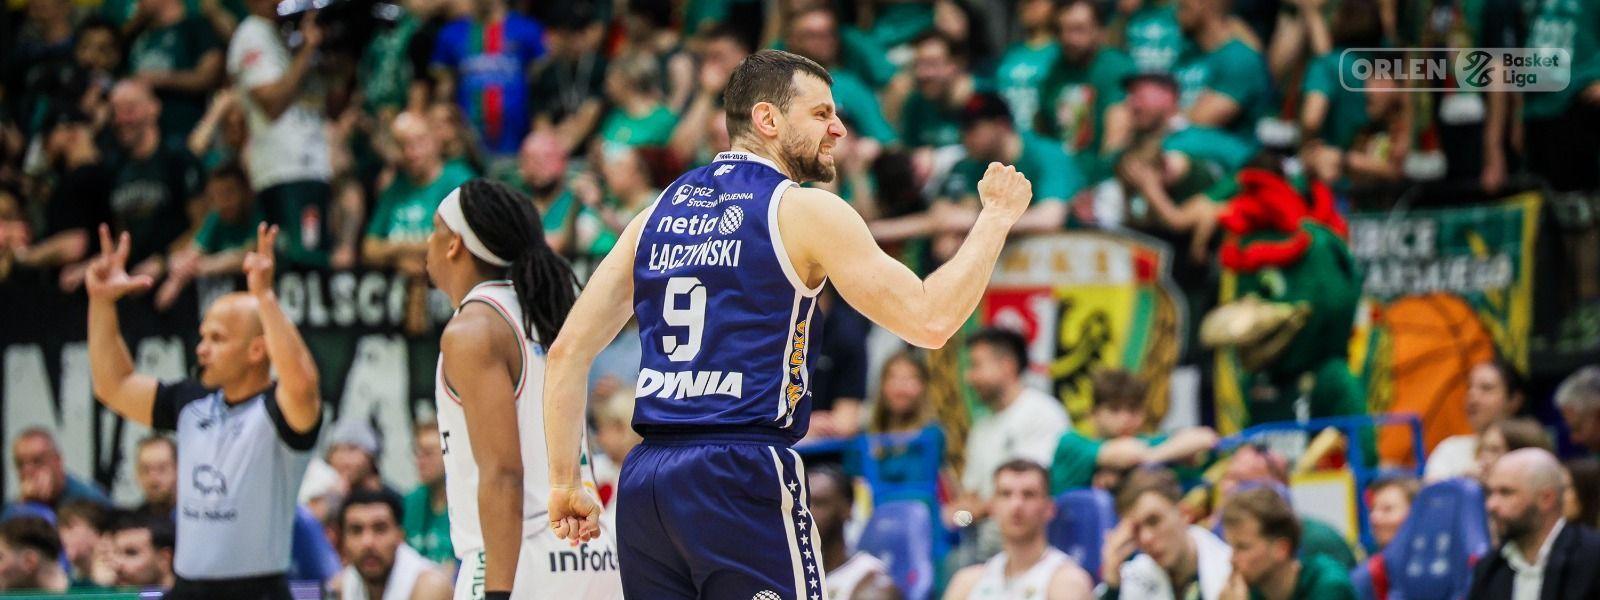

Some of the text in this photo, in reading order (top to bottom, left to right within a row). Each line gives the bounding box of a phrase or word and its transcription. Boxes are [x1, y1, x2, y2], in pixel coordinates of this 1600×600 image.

[692, 187, 714, 197] PGZ
[656, 213, 719, 236] netia
[648, 236, 742, 274] ŁĄCZYŃSKI
[662, 276, 707, 362] 9
[634, 367, 743, 400] DYNIA
[550, 543, 619, 572] infort
